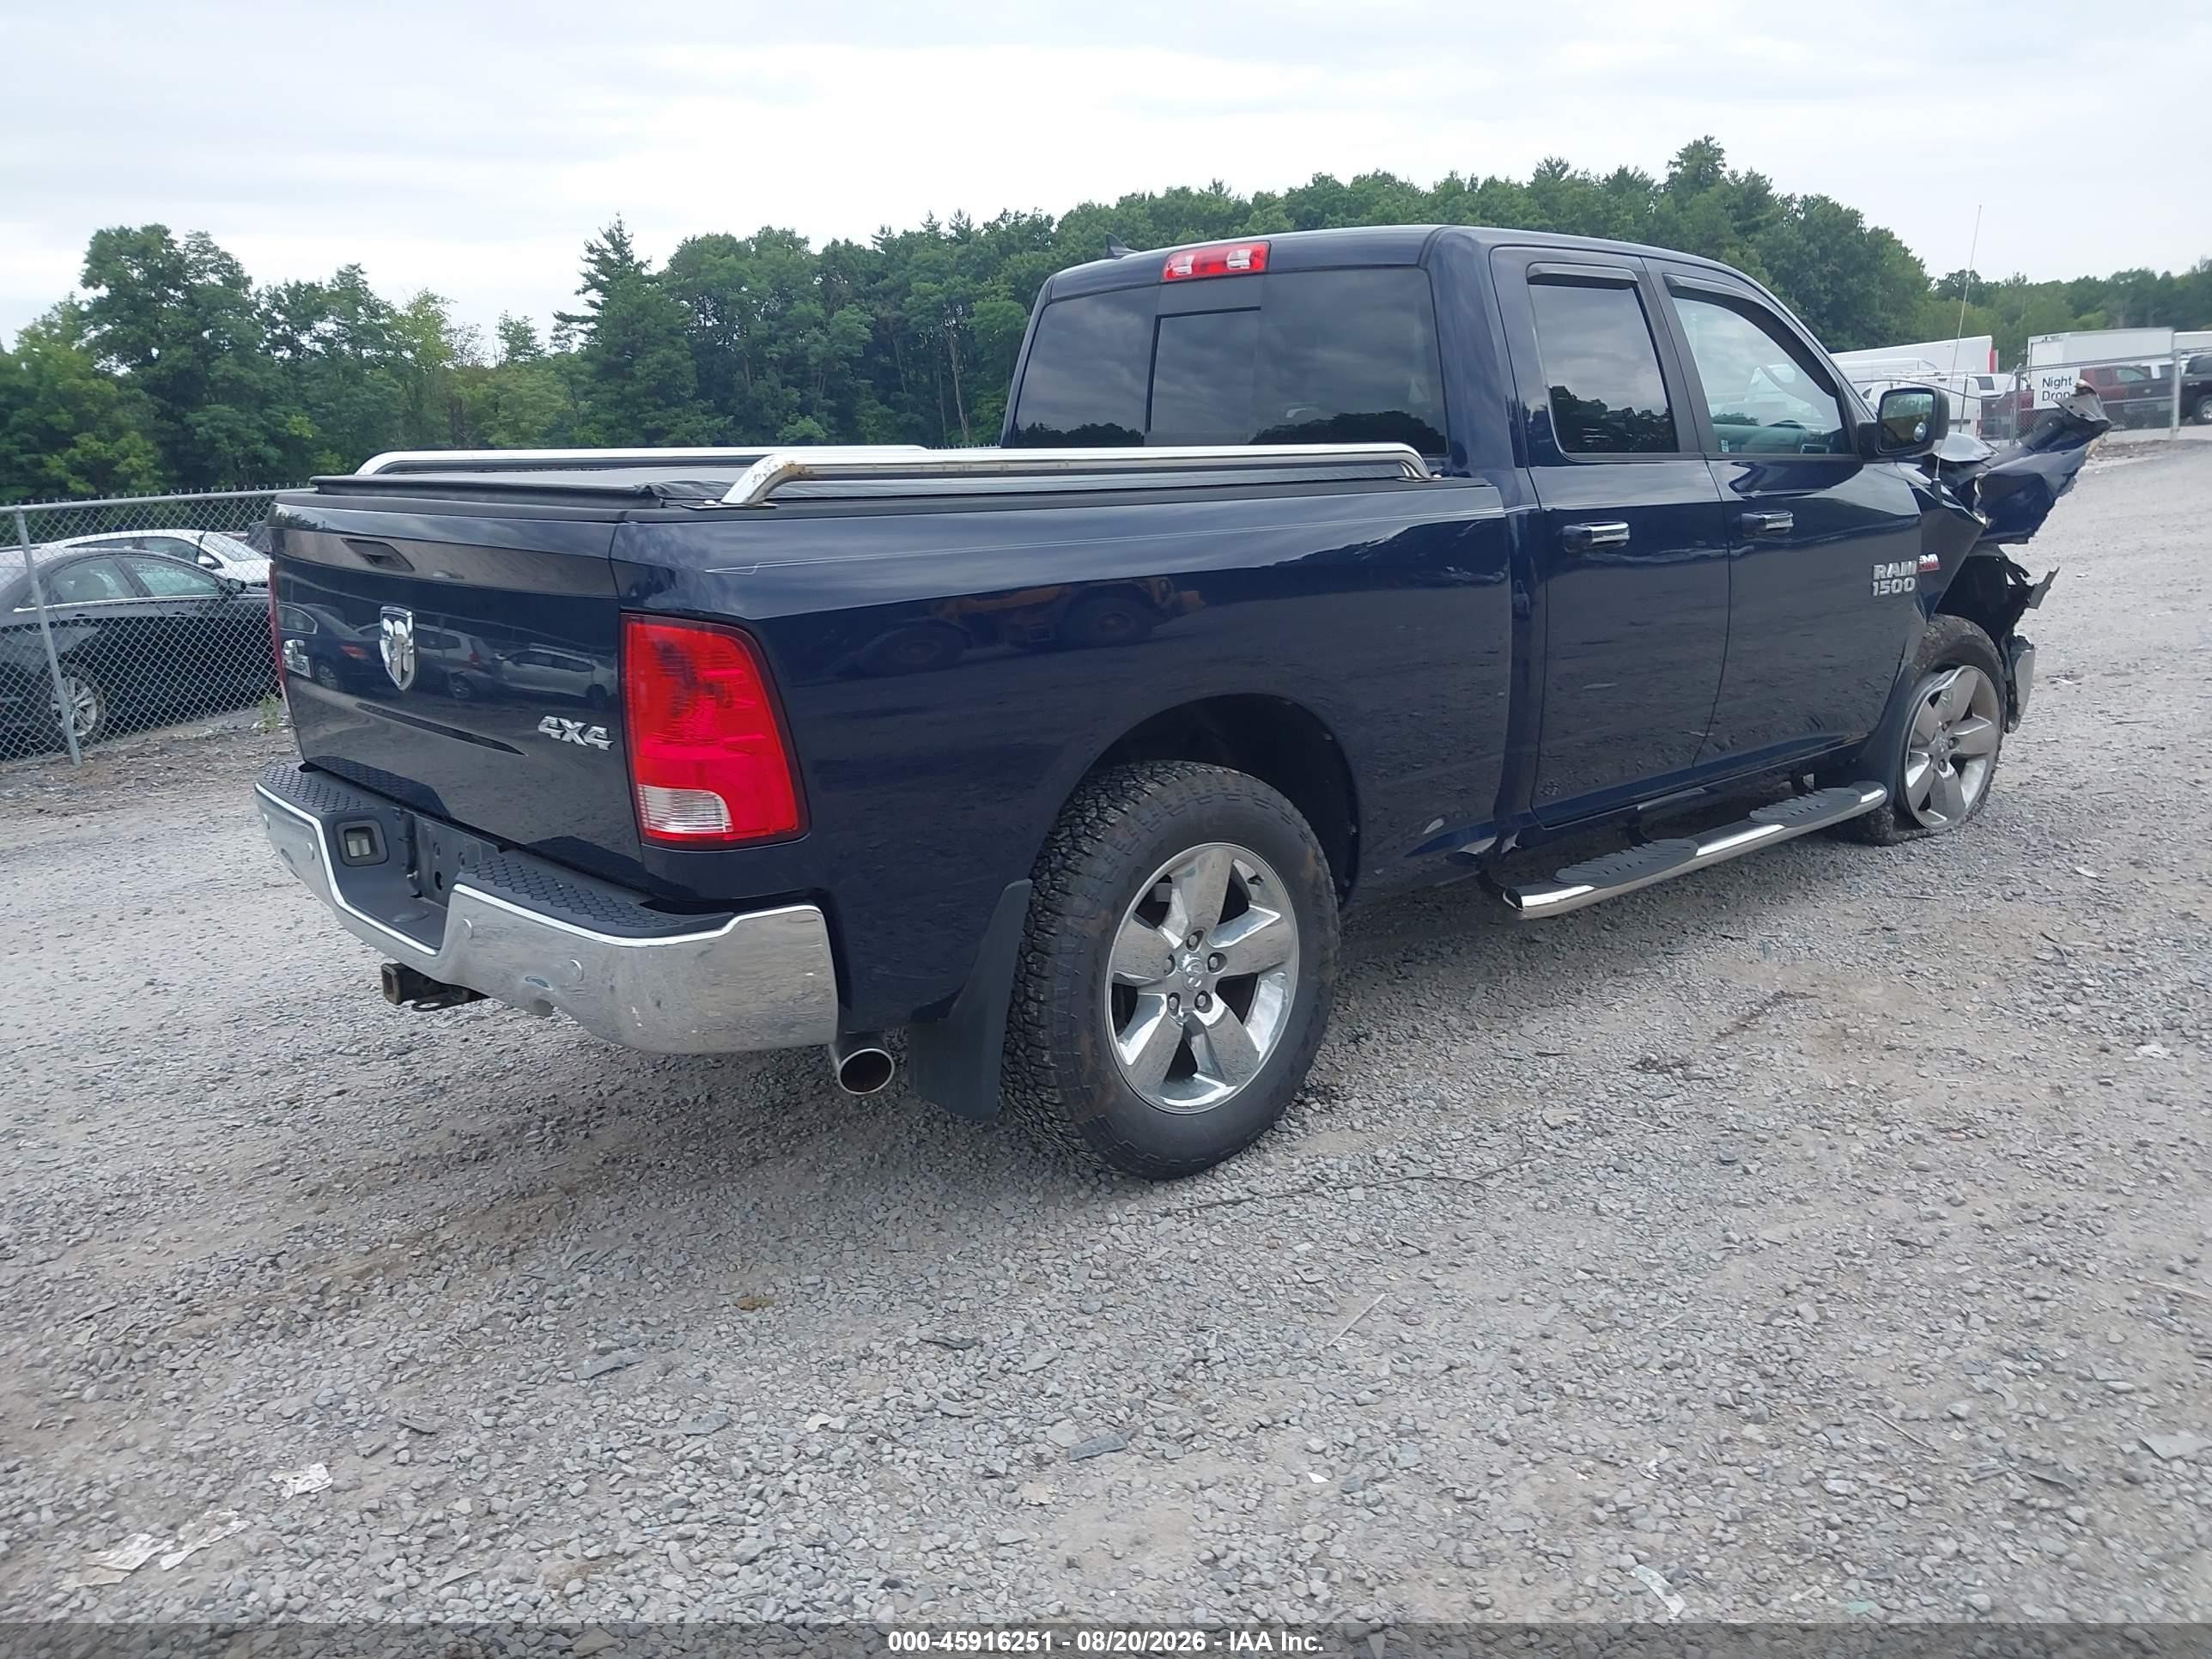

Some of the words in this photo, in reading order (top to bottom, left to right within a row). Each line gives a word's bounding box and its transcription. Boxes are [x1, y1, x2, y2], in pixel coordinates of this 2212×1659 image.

[2042, 376, 2072, 389] Night
[1873, 560, 1917, 580] RAM
[1872, 577, 1916, 597] 1500
